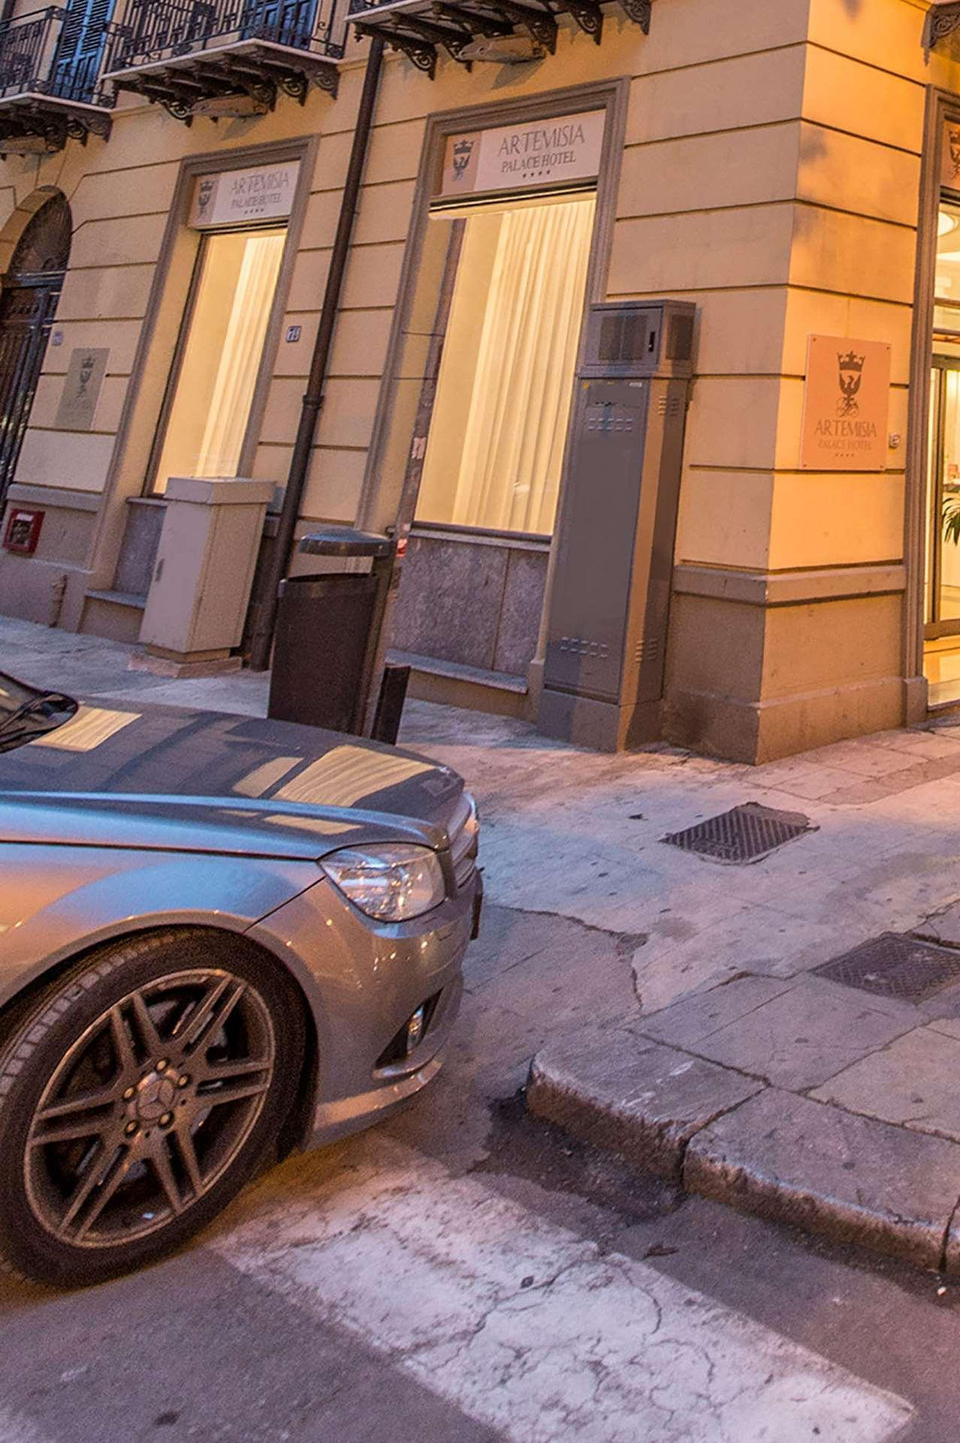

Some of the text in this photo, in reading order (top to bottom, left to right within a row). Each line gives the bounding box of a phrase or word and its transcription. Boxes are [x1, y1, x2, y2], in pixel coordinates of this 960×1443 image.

[497, 124, 585, 157] ARTEMISIA
[501, 151, 577, 173] PALACE HOTEL
[814, 419, 878, 438] ARTEMISIA
